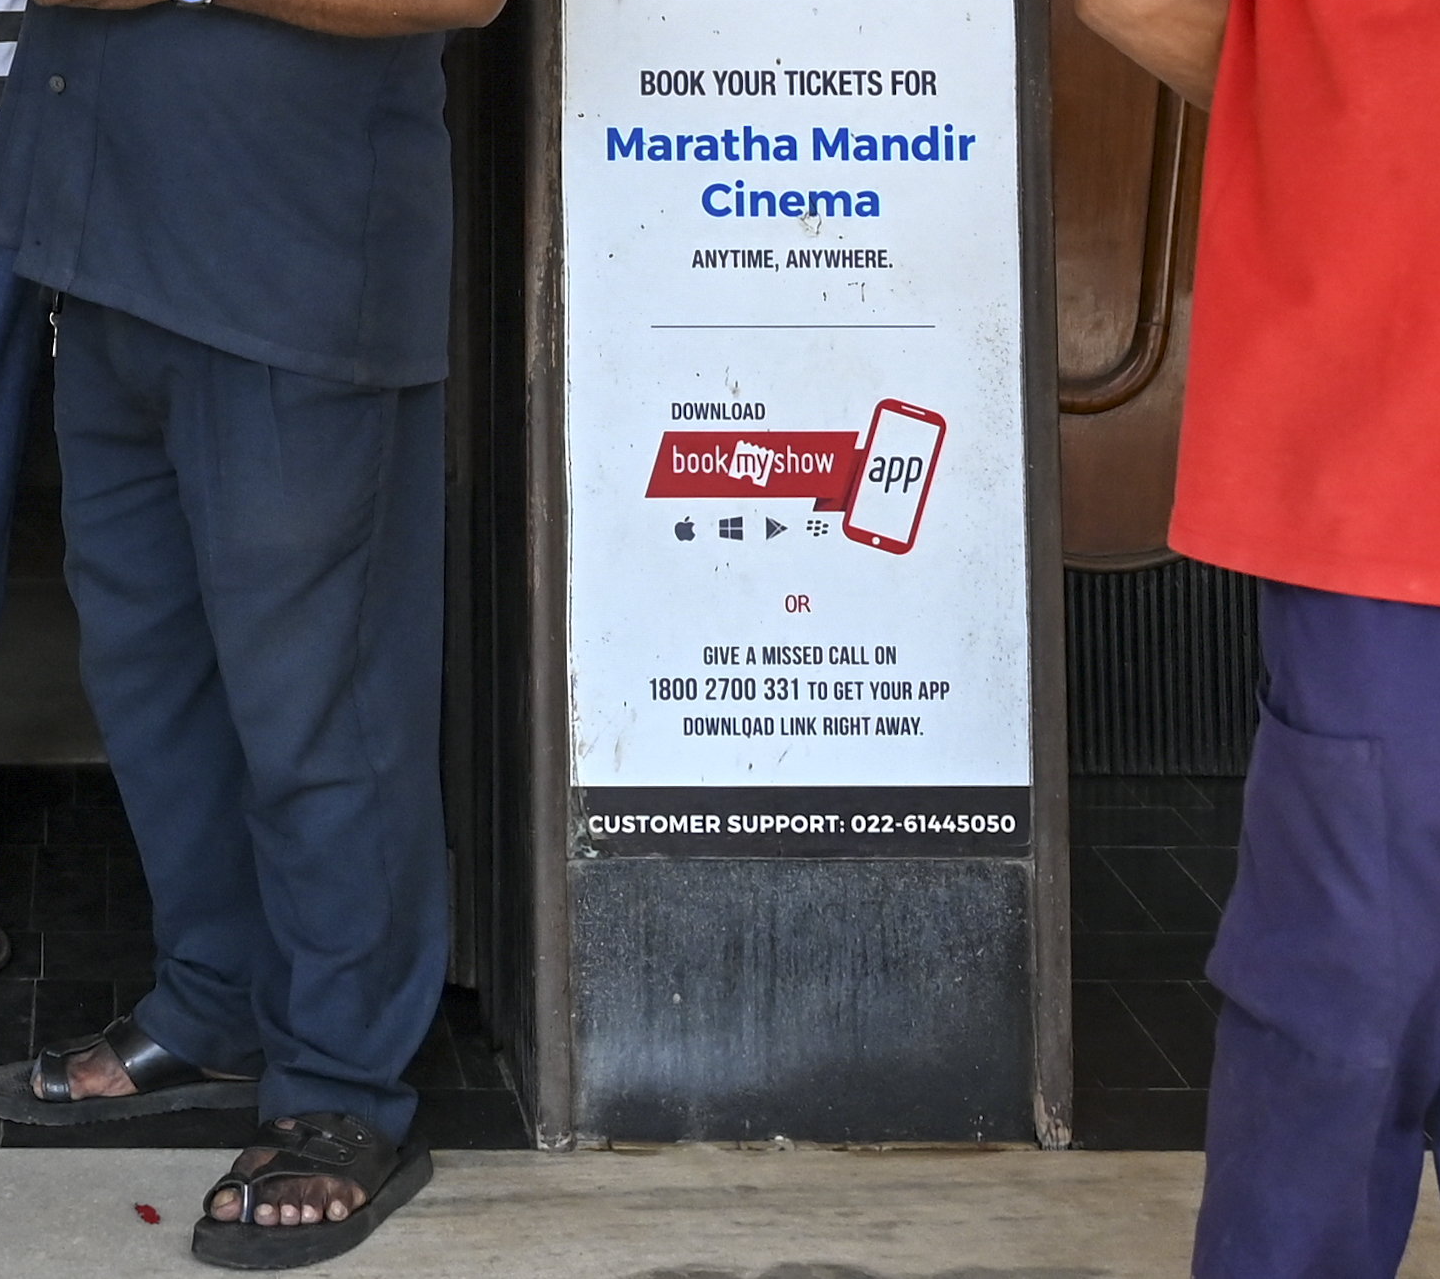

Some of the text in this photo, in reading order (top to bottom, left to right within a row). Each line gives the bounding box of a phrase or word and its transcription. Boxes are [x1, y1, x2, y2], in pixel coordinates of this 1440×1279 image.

[641, 70, 937, 96] BOOK YOUR TICKETS FOR
[606, 124, 975, 161] Maratha Mandir
[701, 180, 880, 217] Cinema
[691, 250, 893, 271] ANYTIME, ANYWHERE.
[671, 402, 766, 421] DOWNLOAD
[672, 439, 923, 494] bookmyshow app
[784, 594, 811, 613] OR
[703, 646, 897, 666] GIVE A MISSED CALL ON
[649, 678, 949, 701] 1800 2700 331 TO GET YOUR APP
[780, 717, 817, 737] LINK
[823, 717, 870, 737] RIGHT
[875, 717, 924, 737] AWAY.
[587, 815, 1016, 834] CUSTOMER SUPPORT: 022-61445050
